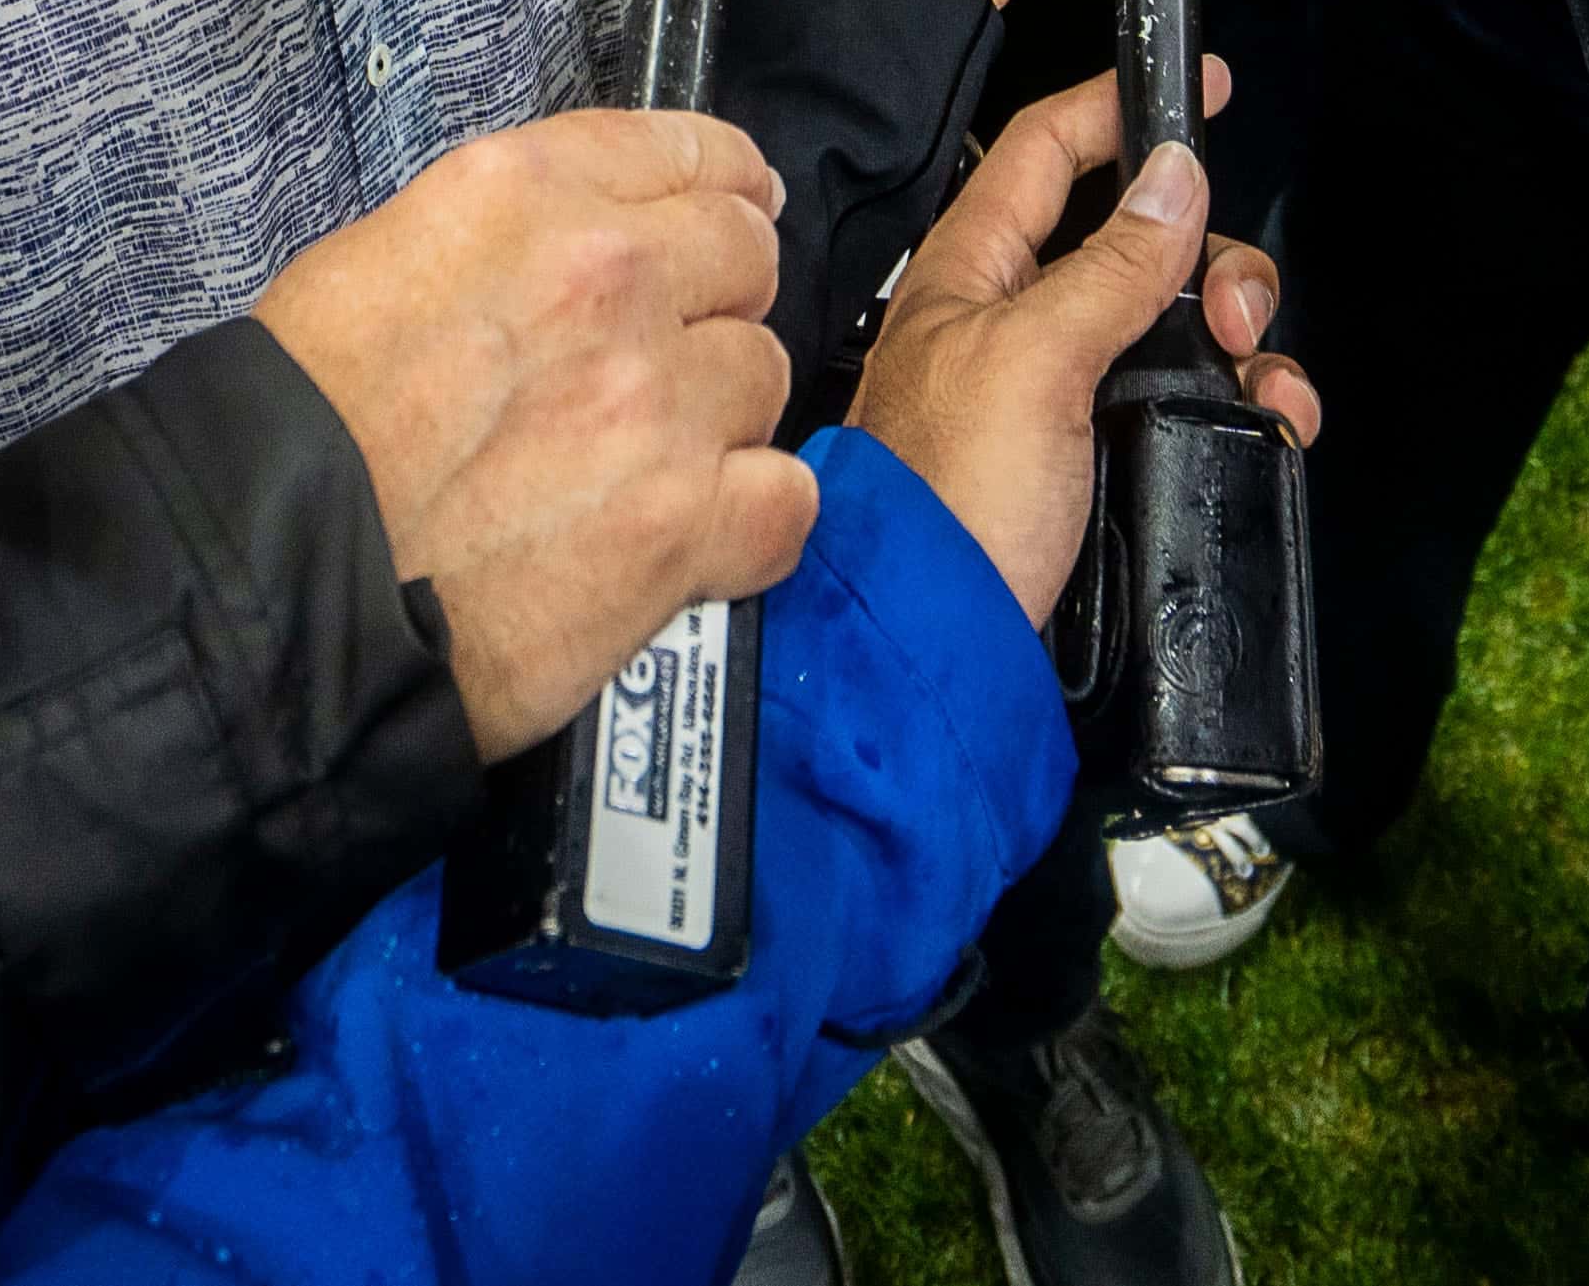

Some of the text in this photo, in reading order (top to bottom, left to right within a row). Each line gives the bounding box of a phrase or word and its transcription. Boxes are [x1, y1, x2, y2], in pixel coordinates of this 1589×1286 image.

[611, 649, 657, 813] FOX 6
[677, 774, 696, 806] Bay
[674, 810, 691, 859] Green
